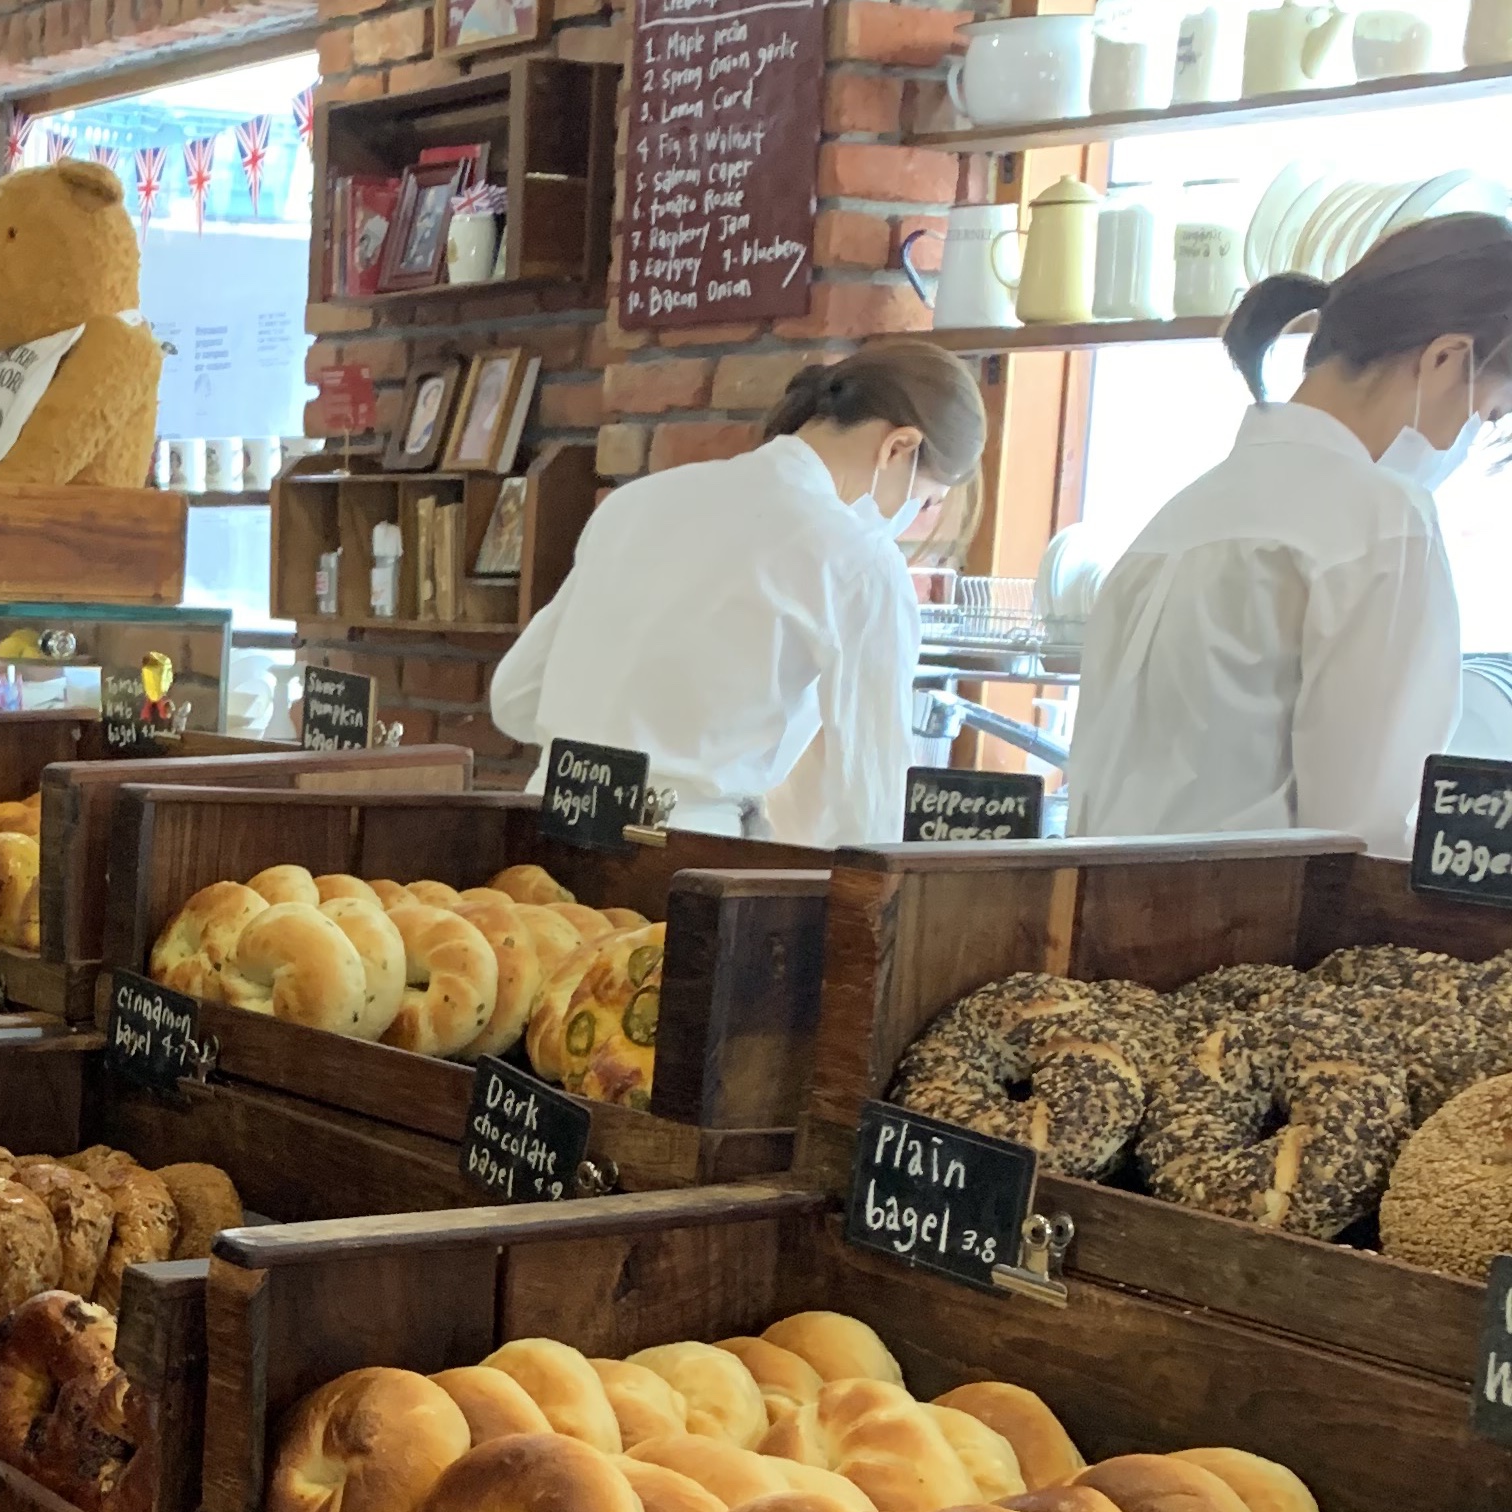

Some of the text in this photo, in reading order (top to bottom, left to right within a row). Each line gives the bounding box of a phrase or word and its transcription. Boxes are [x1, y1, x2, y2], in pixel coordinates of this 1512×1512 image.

[667, 27, 706, 62] Maple
[649, 285, 698, 317] Bacon
[557, 749, 612, 787] Onion
[552, 785, 598, 826] bagel
[1430, 830, 1512, 883] bage
[115, 1015, 151, 1057] bagel
[485, 1073, 539, 1131] Dark
[473, 1111, 557, 1175] chocolate
[874, 1121, 966, 1190] Plain
[468, 1143, 514, 1198] bagel
[864, 1177, 950, 1254] bagel
